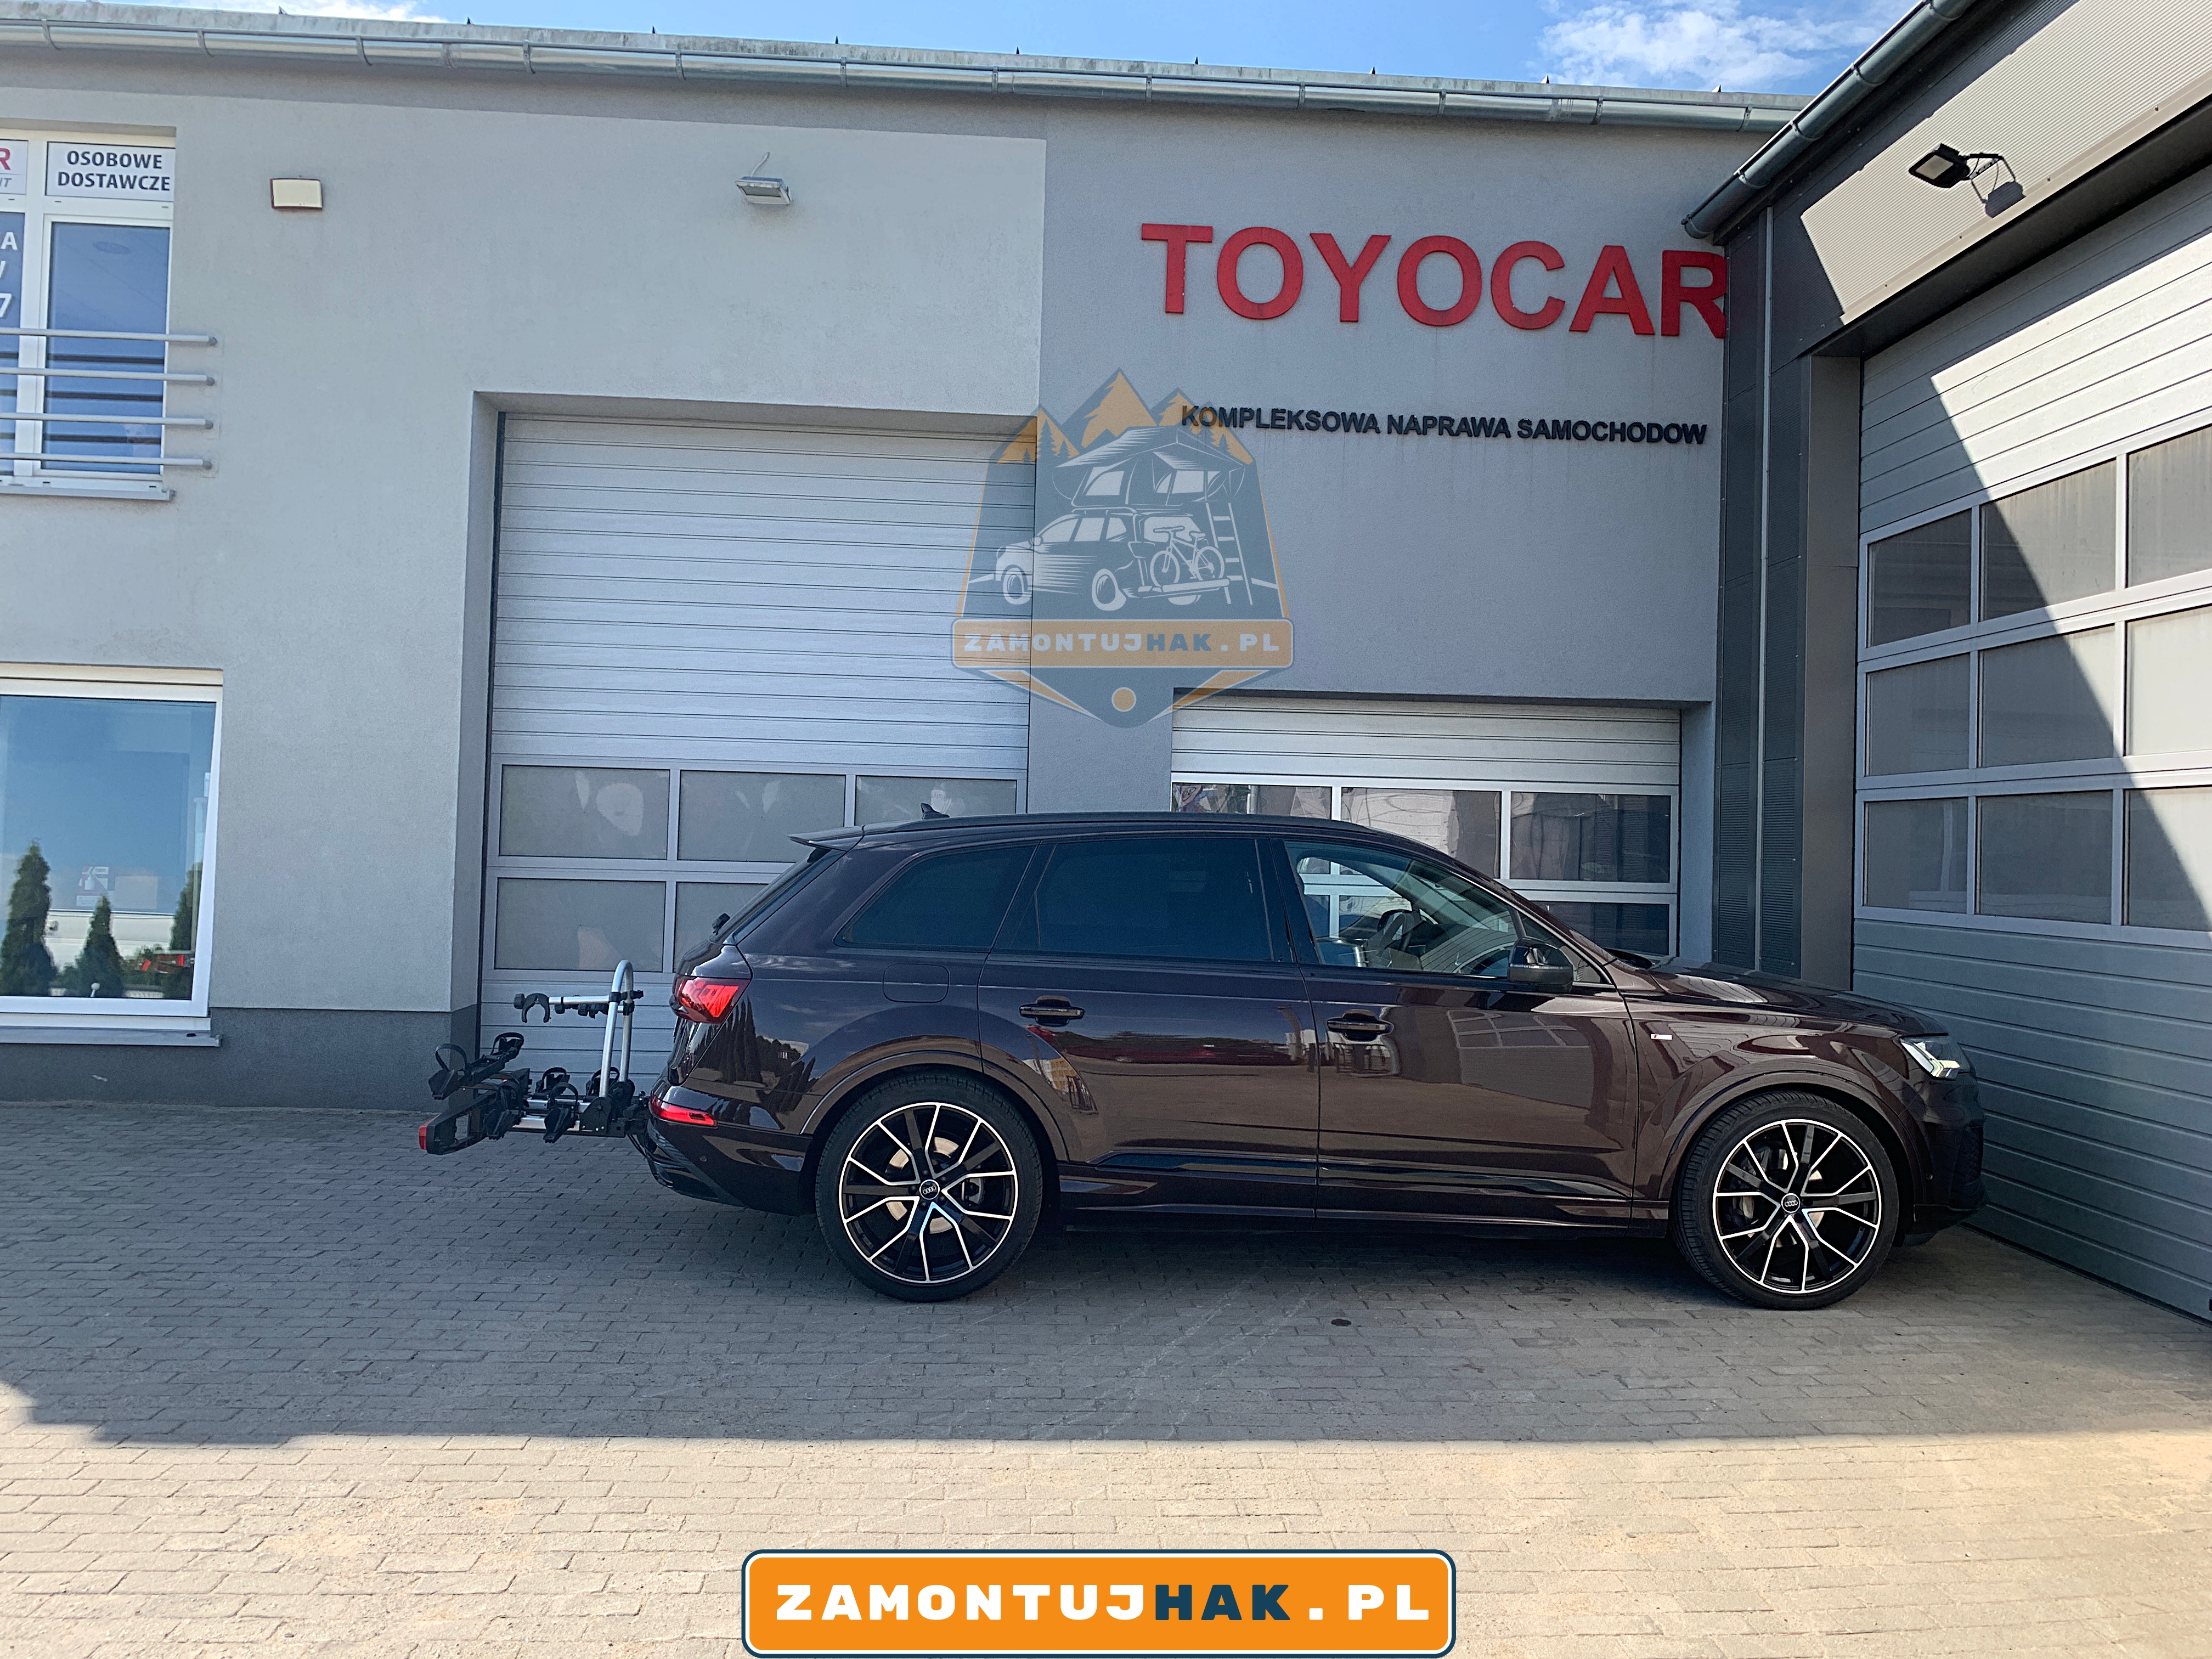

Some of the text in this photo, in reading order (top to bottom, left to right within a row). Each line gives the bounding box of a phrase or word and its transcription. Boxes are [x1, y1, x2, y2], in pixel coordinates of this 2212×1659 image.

[67, 150, 162, 170] OSOBOWE
[58, 171, 171, 191] DOSTAWCZE
[1141, 223, 1727, 339] TOYOCAR
[1181, 405, 1707, 444] KOMPLEKSOWA NAPRAWA SAMOCHODOW
